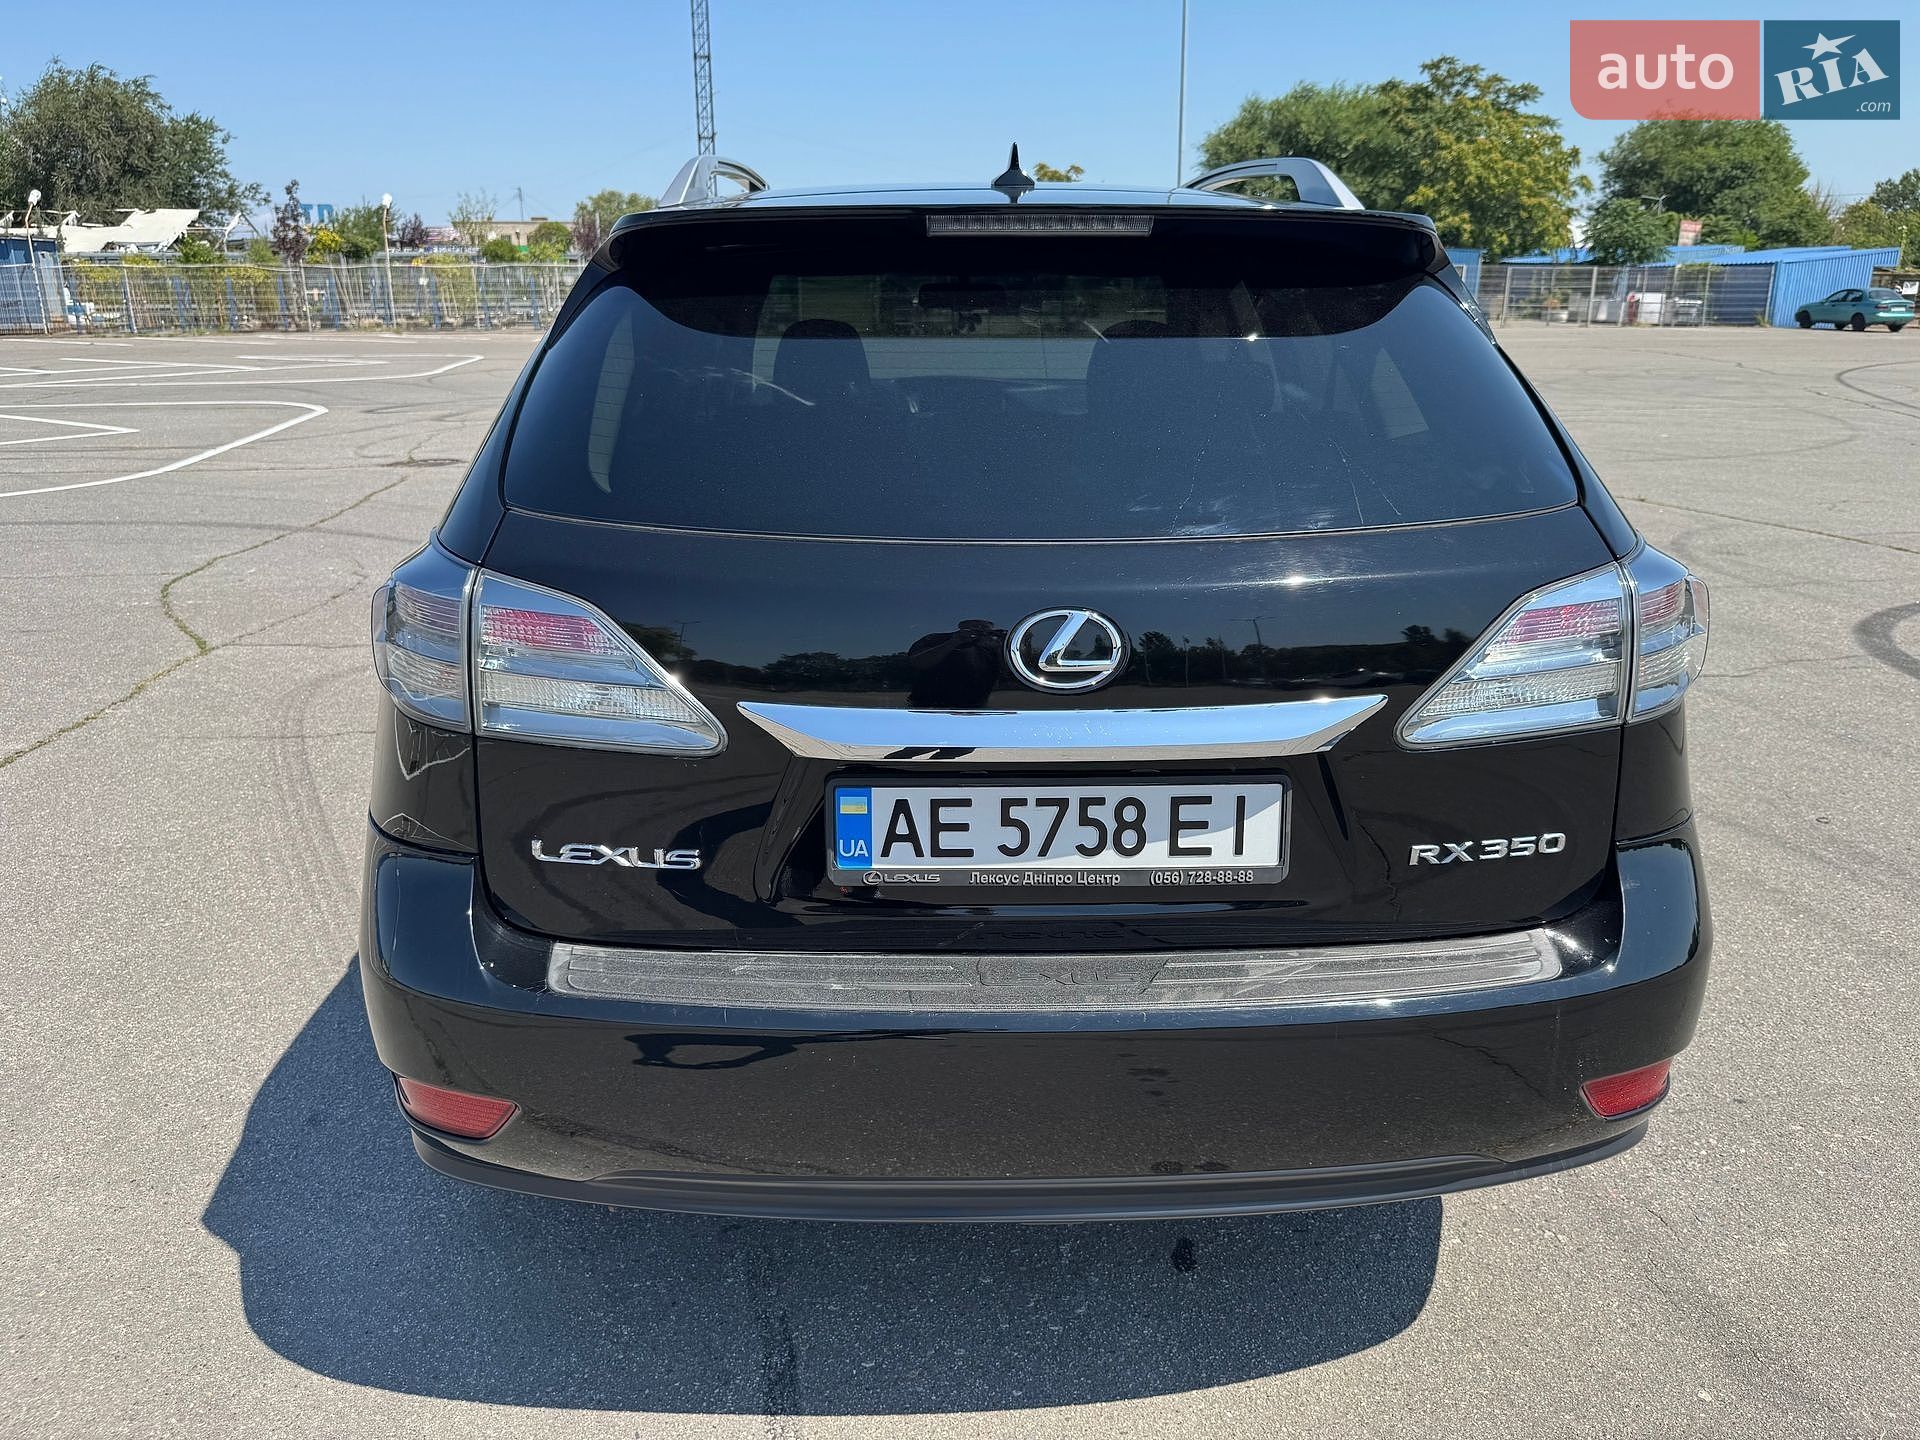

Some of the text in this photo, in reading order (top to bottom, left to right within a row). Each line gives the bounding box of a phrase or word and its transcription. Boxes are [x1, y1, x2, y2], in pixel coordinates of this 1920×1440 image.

[880, 795, 1246, 857] AE 5758 EI
[531, 839, 702, 870] LEXUS
[840, 839, 869, 857] UA
[1409, 832, 1567, 866] RX 350
[884, 873, 941, 884] LEXUS
[968, 872, 1121, 886] Лексус Дніпро Центр
[1150, 870, 1254, 885] (056) 728-88-88
